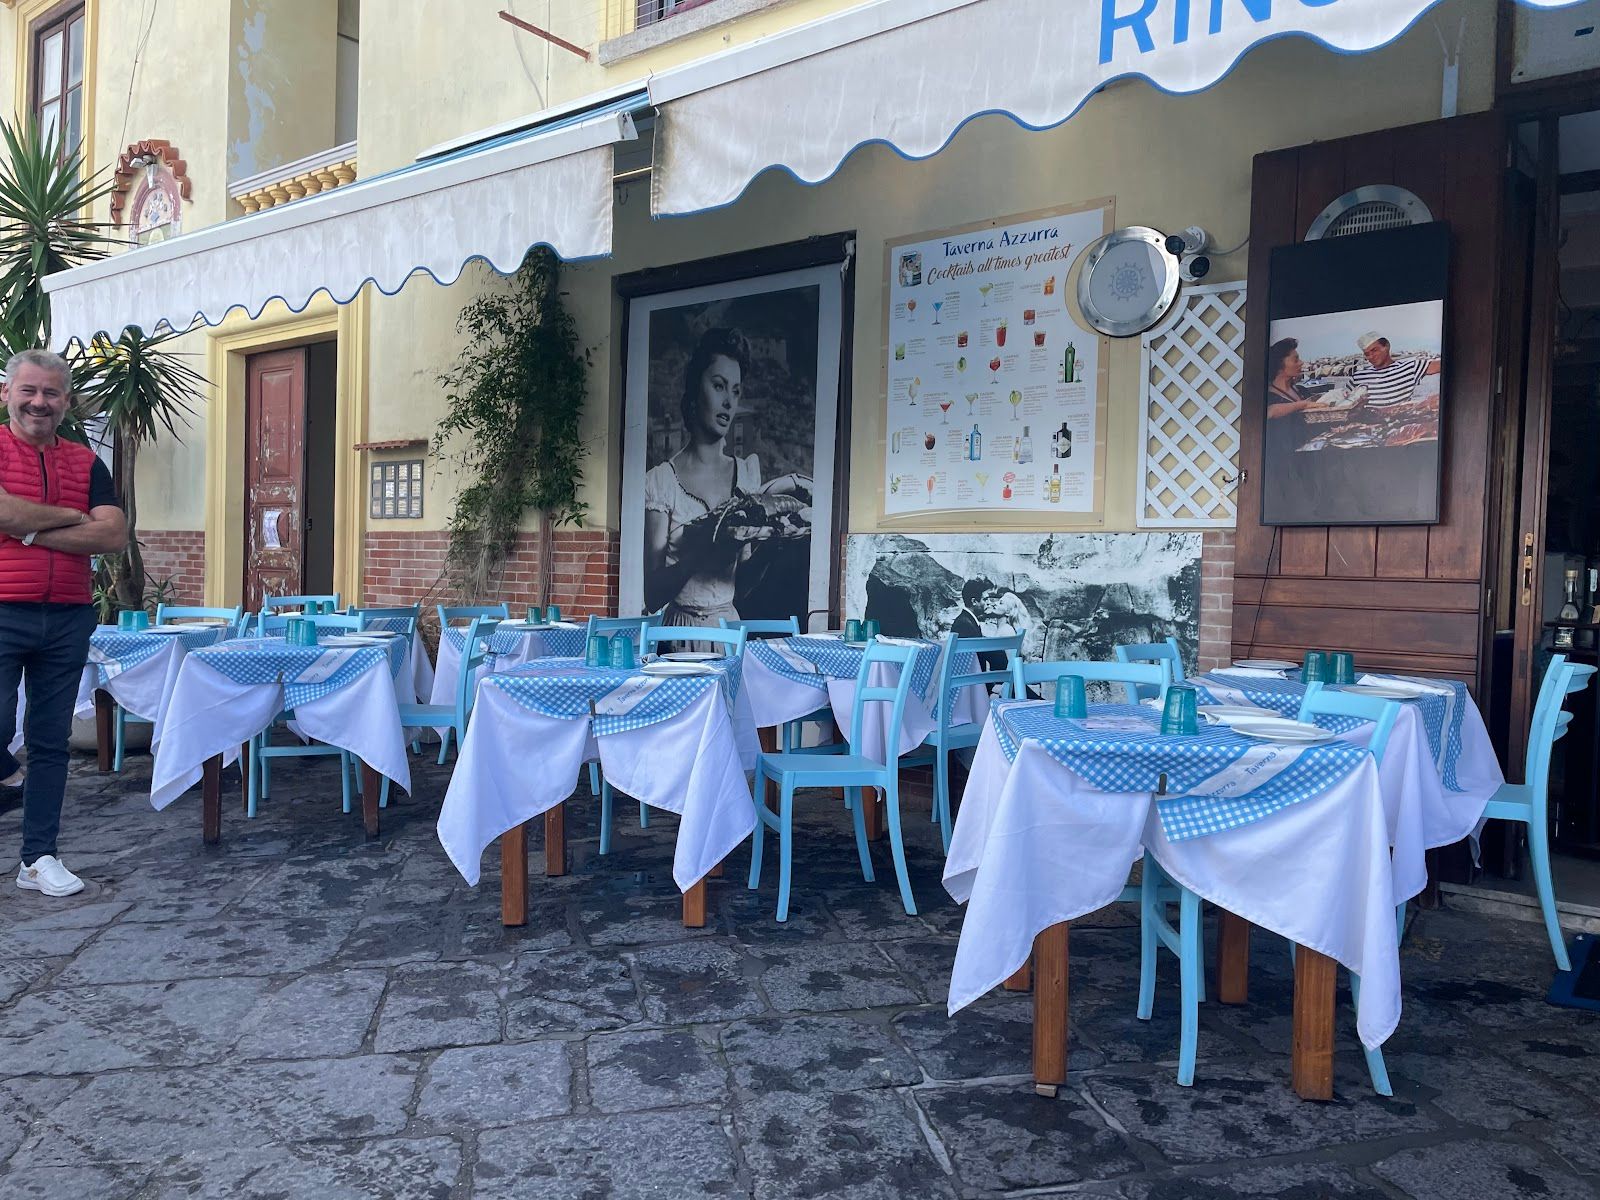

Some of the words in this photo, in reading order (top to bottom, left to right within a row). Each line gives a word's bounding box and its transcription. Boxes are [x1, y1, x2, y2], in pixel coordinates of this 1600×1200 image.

[1098, 0, 1340, 66] RI
[942, 238, 994, 257] Taverna
[1000, 227, 1059, 247] Azzurra
[927, 260, 975, 285] Cocktails
[977, 256, 993, 273] all
[993, 256, 1021, 271] times
[1024, 243, 1075, 271] greatest
[1244, 751, 1277, 775] Taverna
